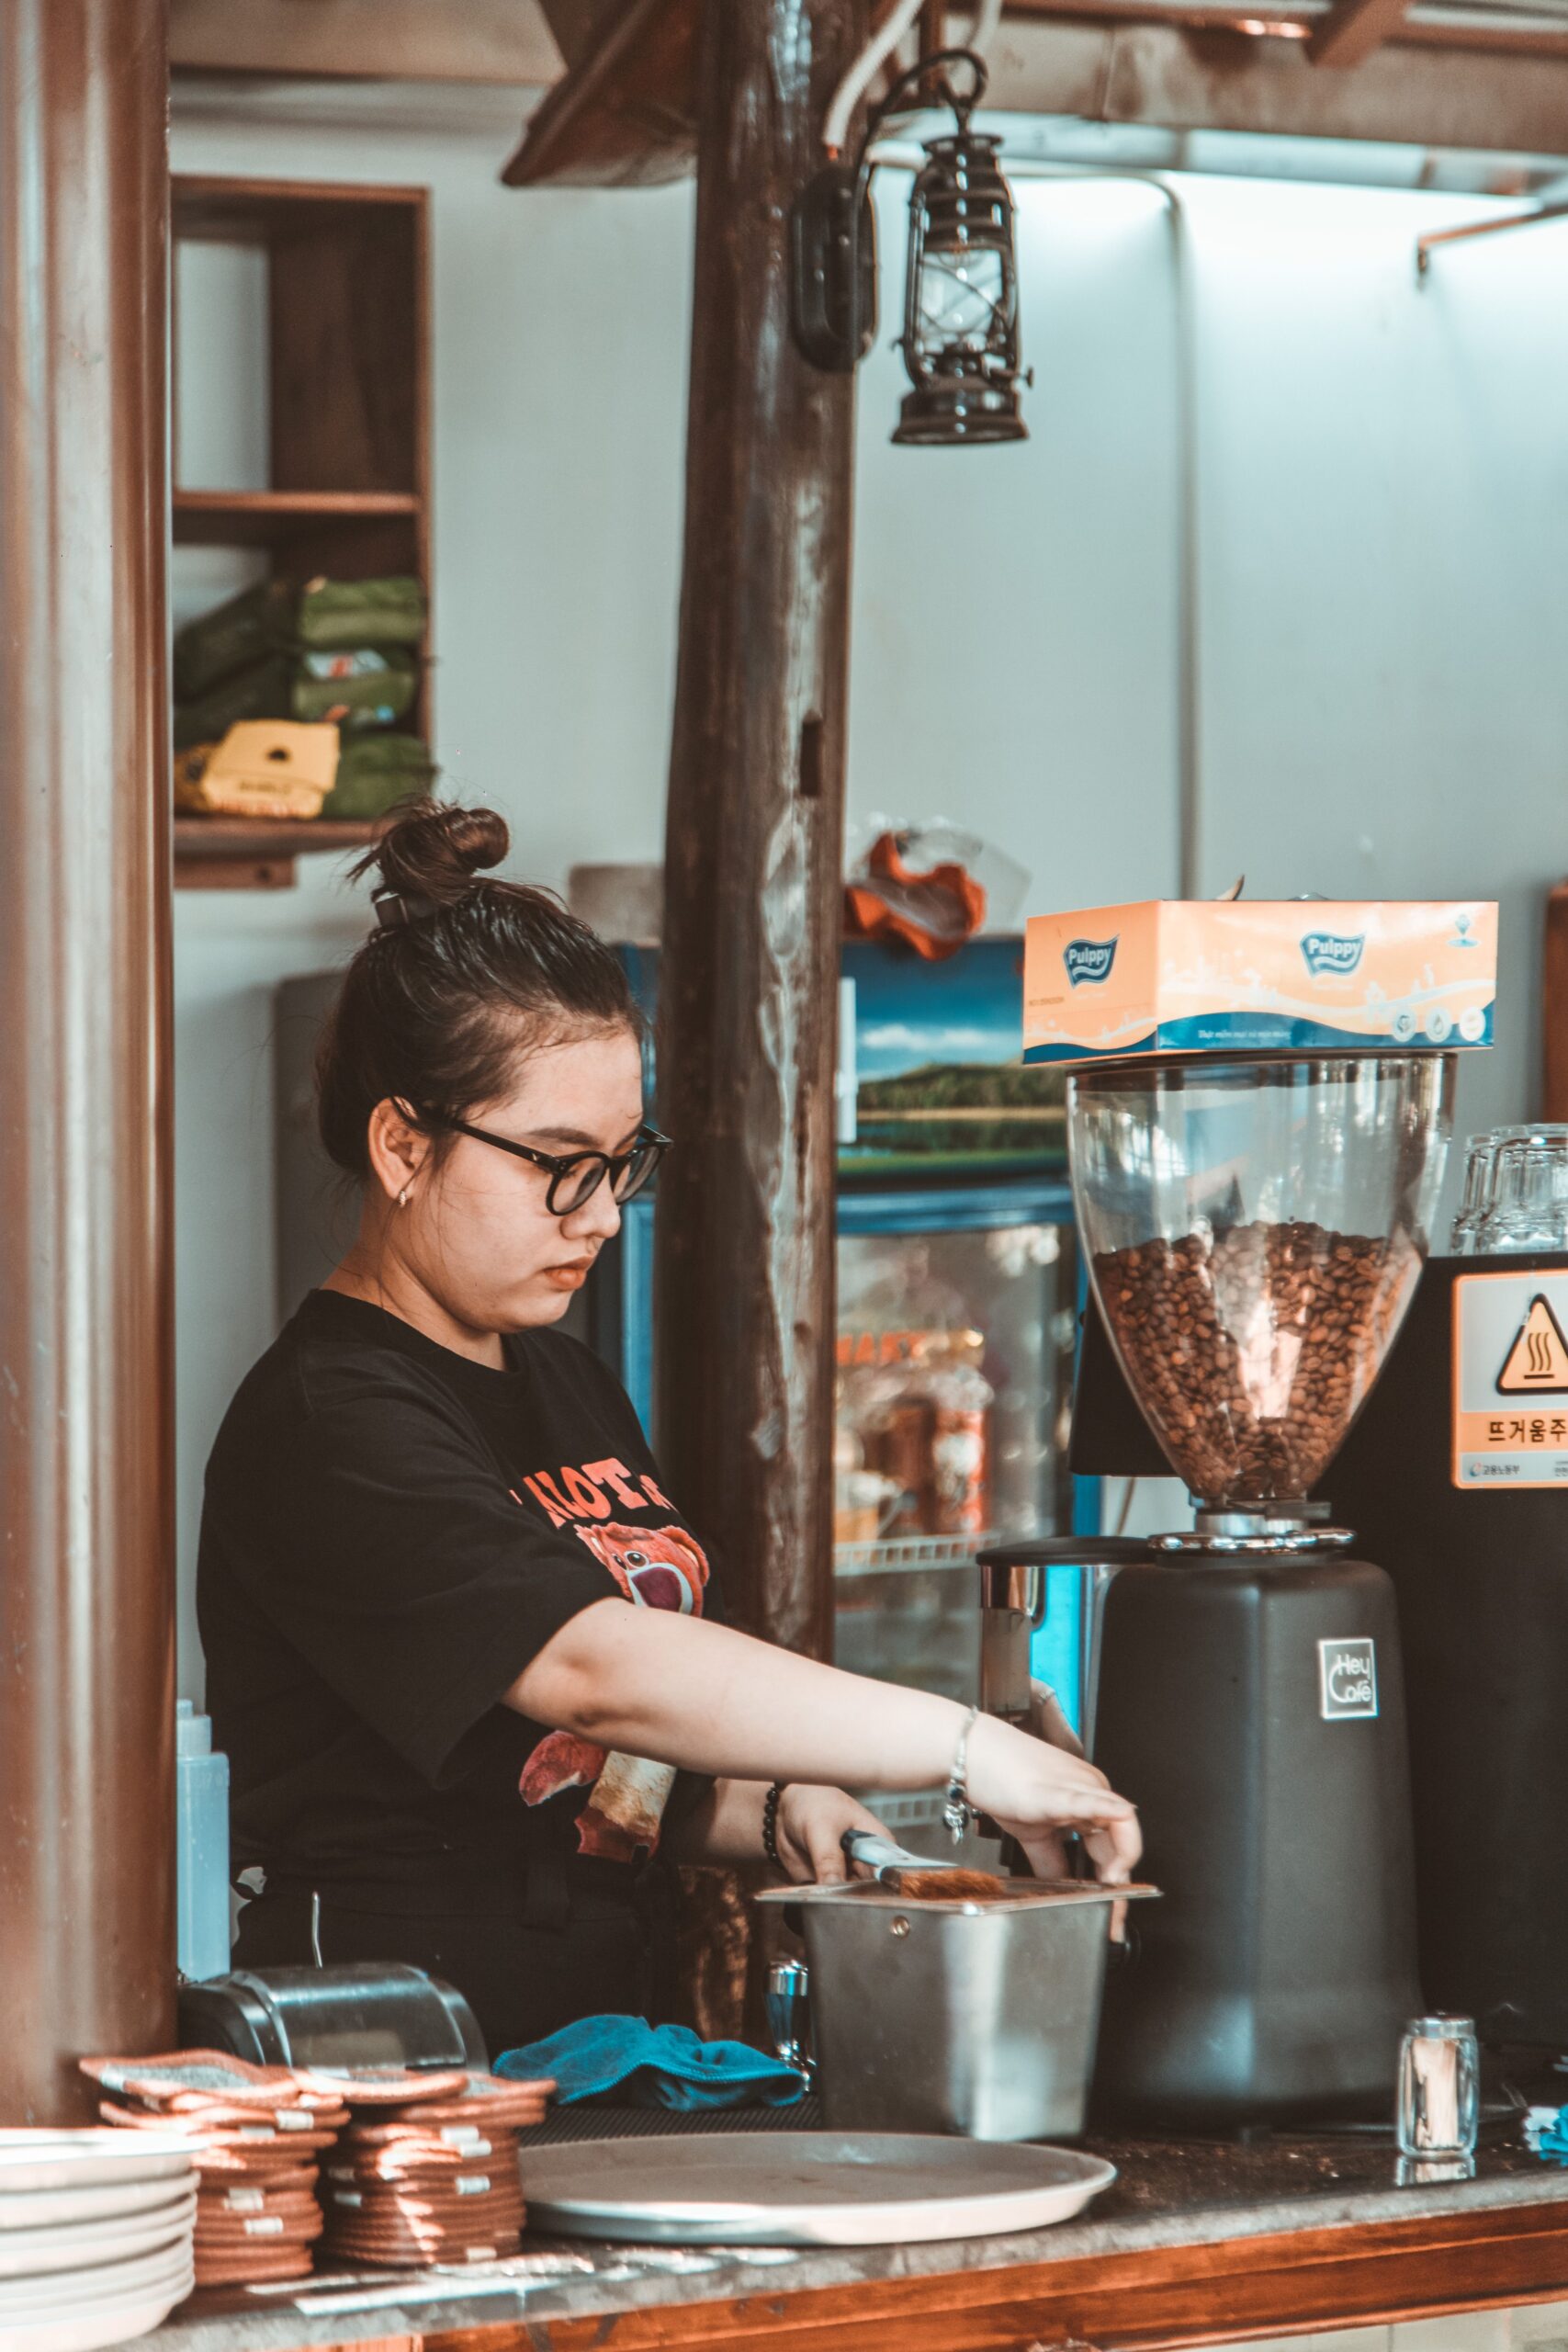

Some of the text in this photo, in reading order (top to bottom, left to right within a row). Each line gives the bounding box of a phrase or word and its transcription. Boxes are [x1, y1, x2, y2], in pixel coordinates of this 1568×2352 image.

[1067, 946, 1111, 967] Pulppy
[1306, 937, 1361, 960] Pulppy
[1487, 1418, 1567, 1443] 뜨거움주
[1337, 1653, 1371, 1679] Hey
